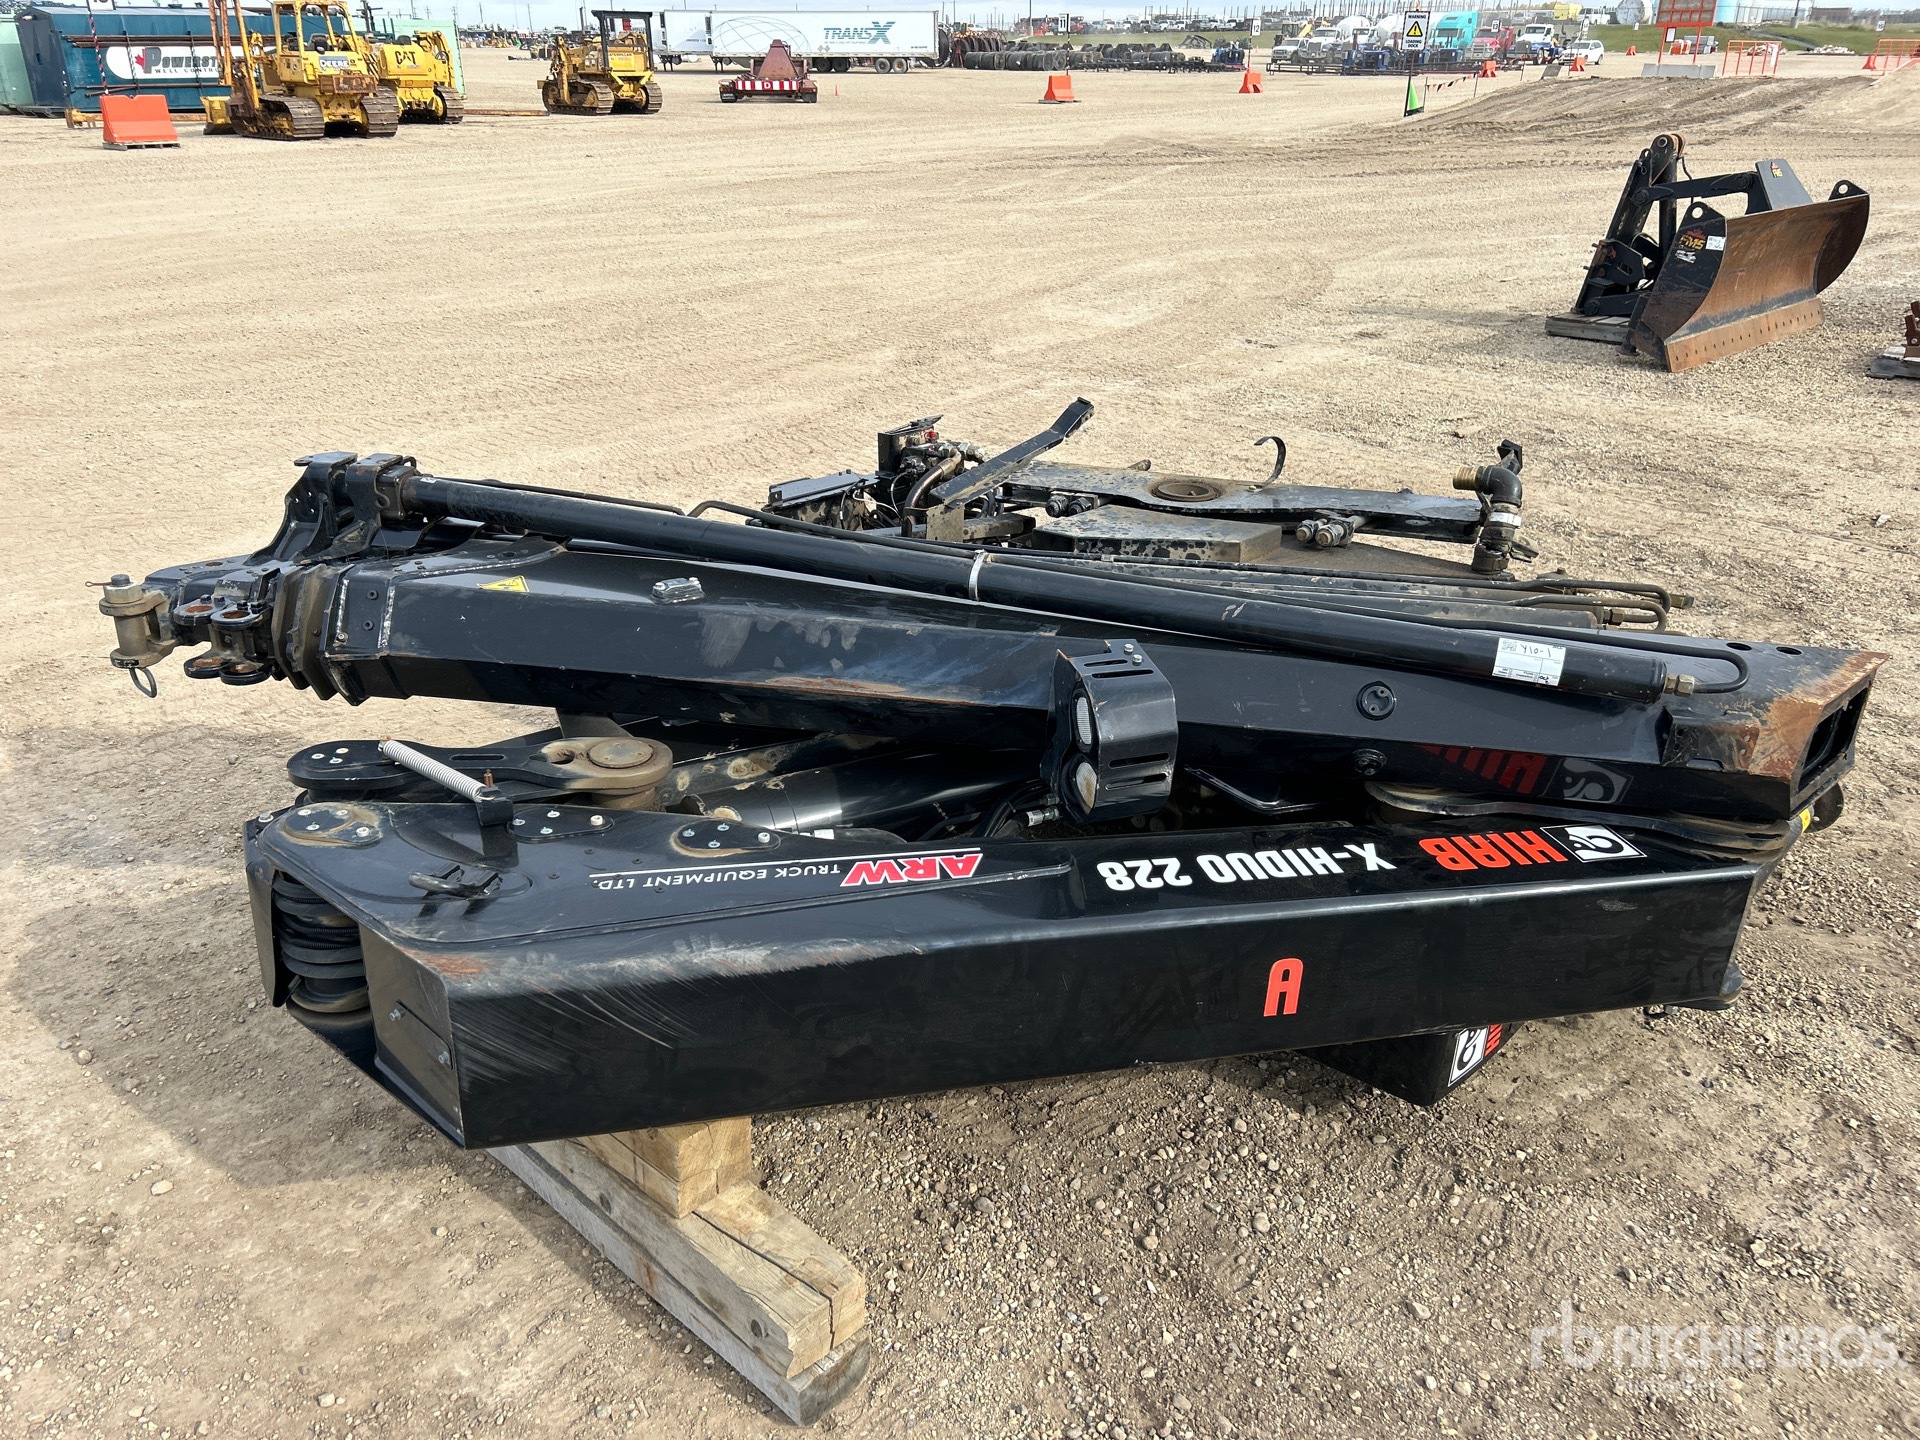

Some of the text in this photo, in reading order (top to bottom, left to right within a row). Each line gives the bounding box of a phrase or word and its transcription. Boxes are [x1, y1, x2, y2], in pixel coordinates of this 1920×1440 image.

[1060, 19, 1066, 28] 11
[1253, 24, 1260, 33] 12
[144, 46, 219, 74] POWERST
[319, 59, 350, 68] DEERE
[394, 50, 416, 65] CAT
[763, 81, 771, 89] D
[1418, 830, 1569, 871] HIAB
[774, 863, 841, 878] TRUCK
[840, 853, 984, 887] ARW
[1096, 843, 1398, 891] X-HIDUO 228
[642, 867, 767, 889] EQUIPMENT
[1263, 957, 1304, 1017] A
